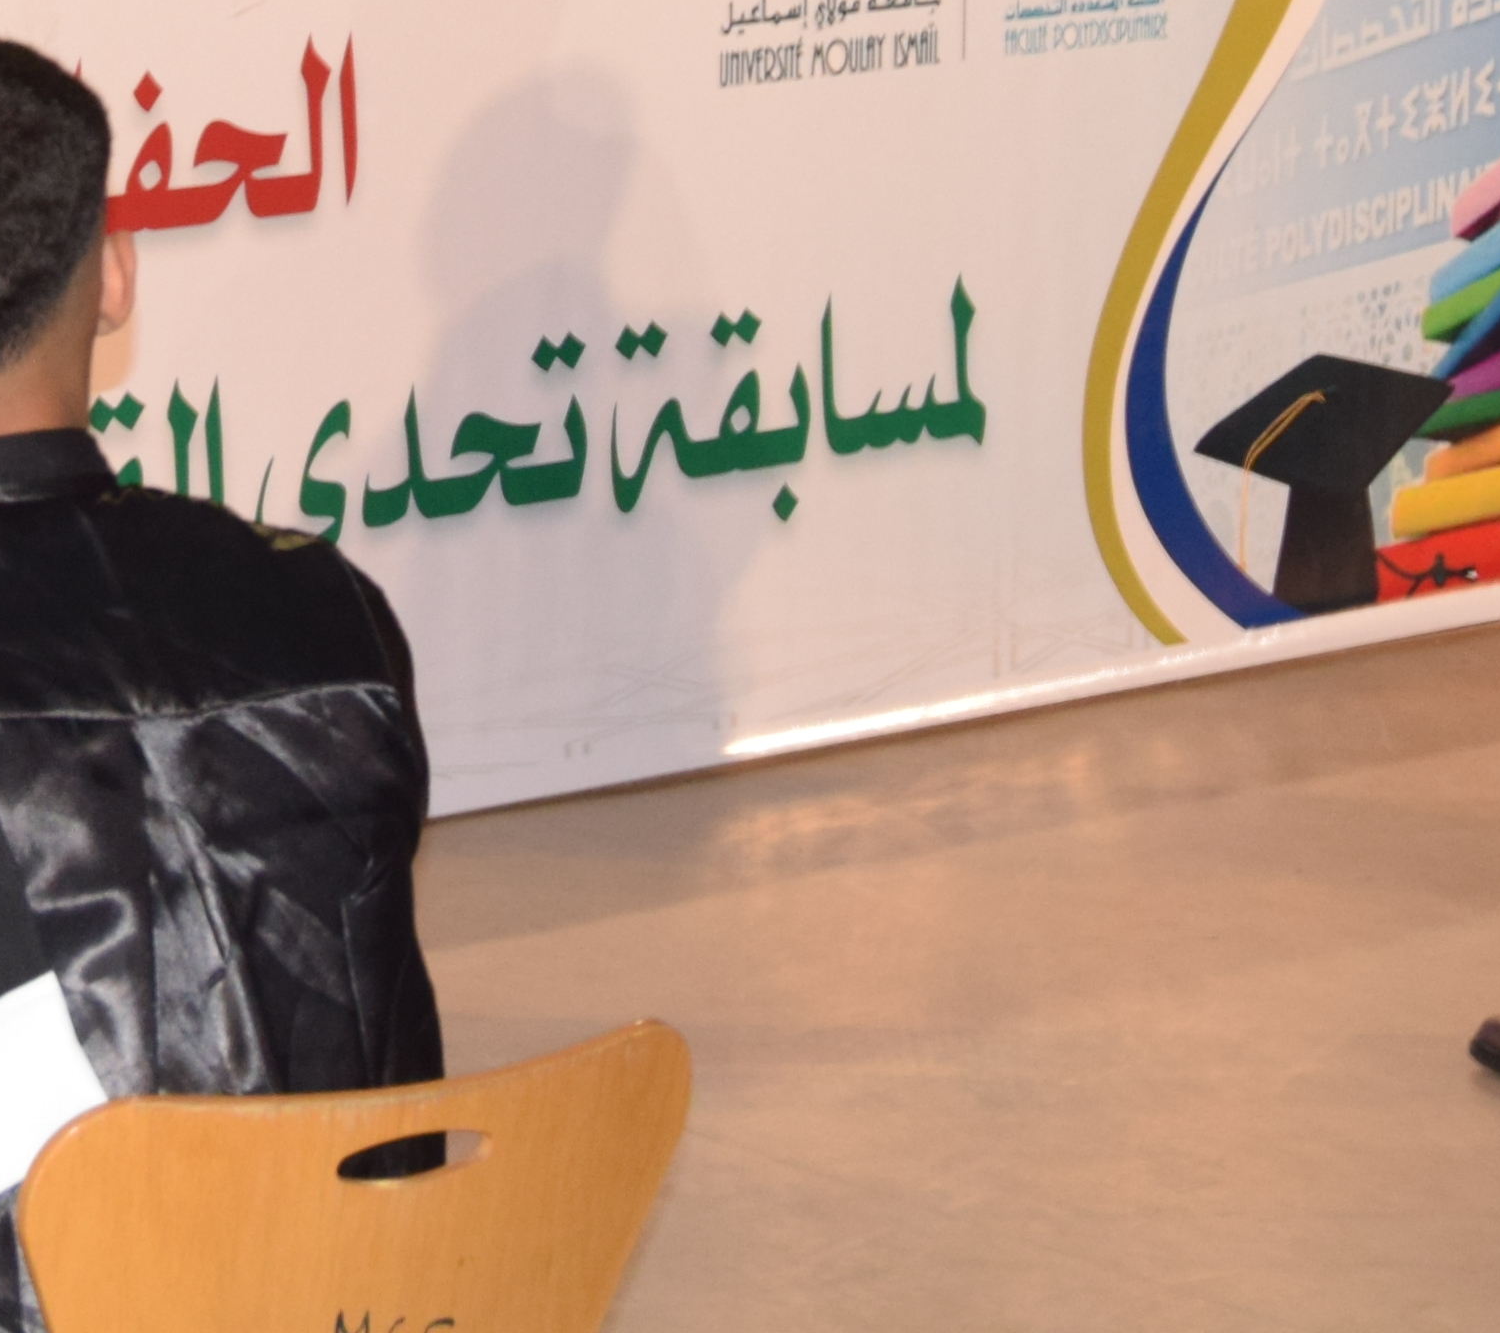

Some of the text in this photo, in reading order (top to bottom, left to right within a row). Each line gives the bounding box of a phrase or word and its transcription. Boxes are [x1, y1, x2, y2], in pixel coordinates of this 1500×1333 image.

[72, 31, 358, 236] الحف
[719, 36, 804, 89] UNIVERSITÉ
[811, 32, 887, 78] MOULAY
[610, 272, 987, 522] لمسابقة
